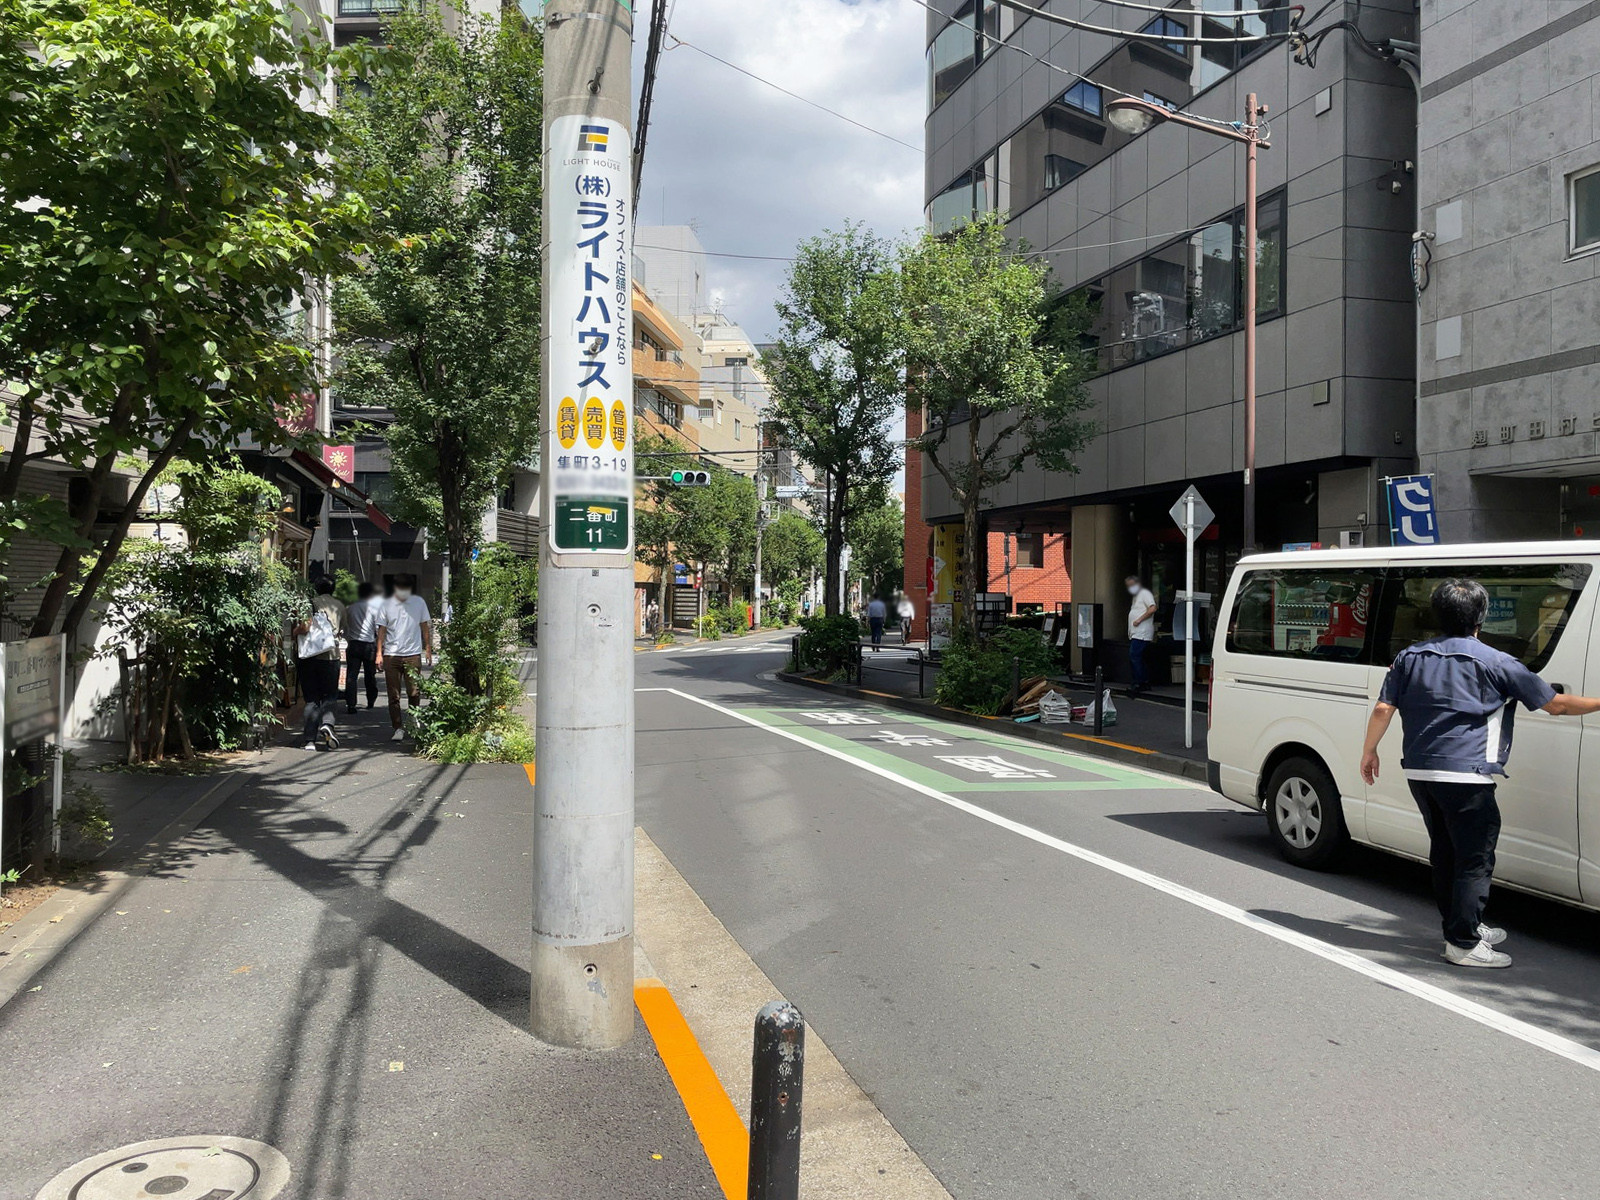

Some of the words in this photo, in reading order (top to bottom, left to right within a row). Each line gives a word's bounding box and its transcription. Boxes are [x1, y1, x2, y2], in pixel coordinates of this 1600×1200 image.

[563, 158, 590, 166] LIGHT
[593, 159, 621, 171] HOUSE
[560, 406, 575, 440] 賃貸
[586, 406, 603, 440] 売買
[612, 408, 625, 443] 管理
[569, 505, 618, 523] 二番町
[585, 528, 602, 543] 11
